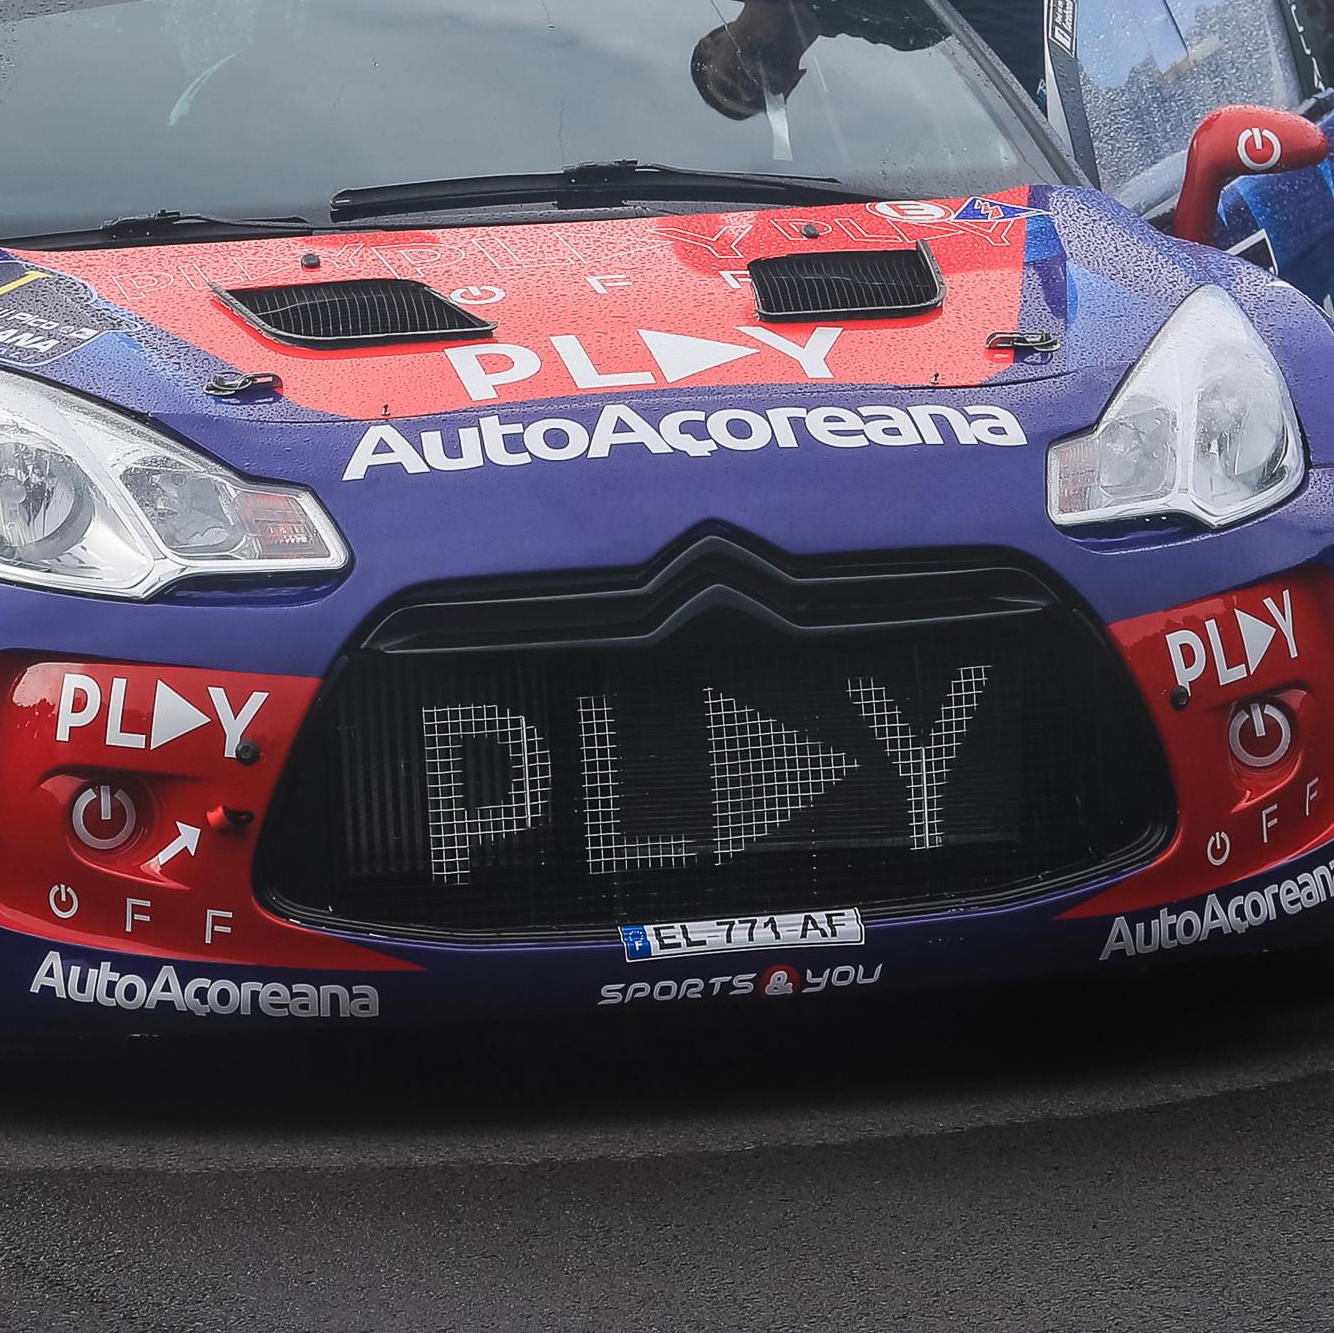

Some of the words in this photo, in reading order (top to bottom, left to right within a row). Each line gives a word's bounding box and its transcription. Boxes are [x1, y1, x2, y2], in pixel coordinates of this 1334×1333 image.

[444, 326, 843, 401] PLAY
[341, 404, 1028, 481] AutoAçoreana
[1165, 588, 1299, 697] PLAY
[55, 672, 269, 758] PLAY
[421, 665, 992, 885] PLAY
[29, 950, 380, 1018] AutoAçoreana
